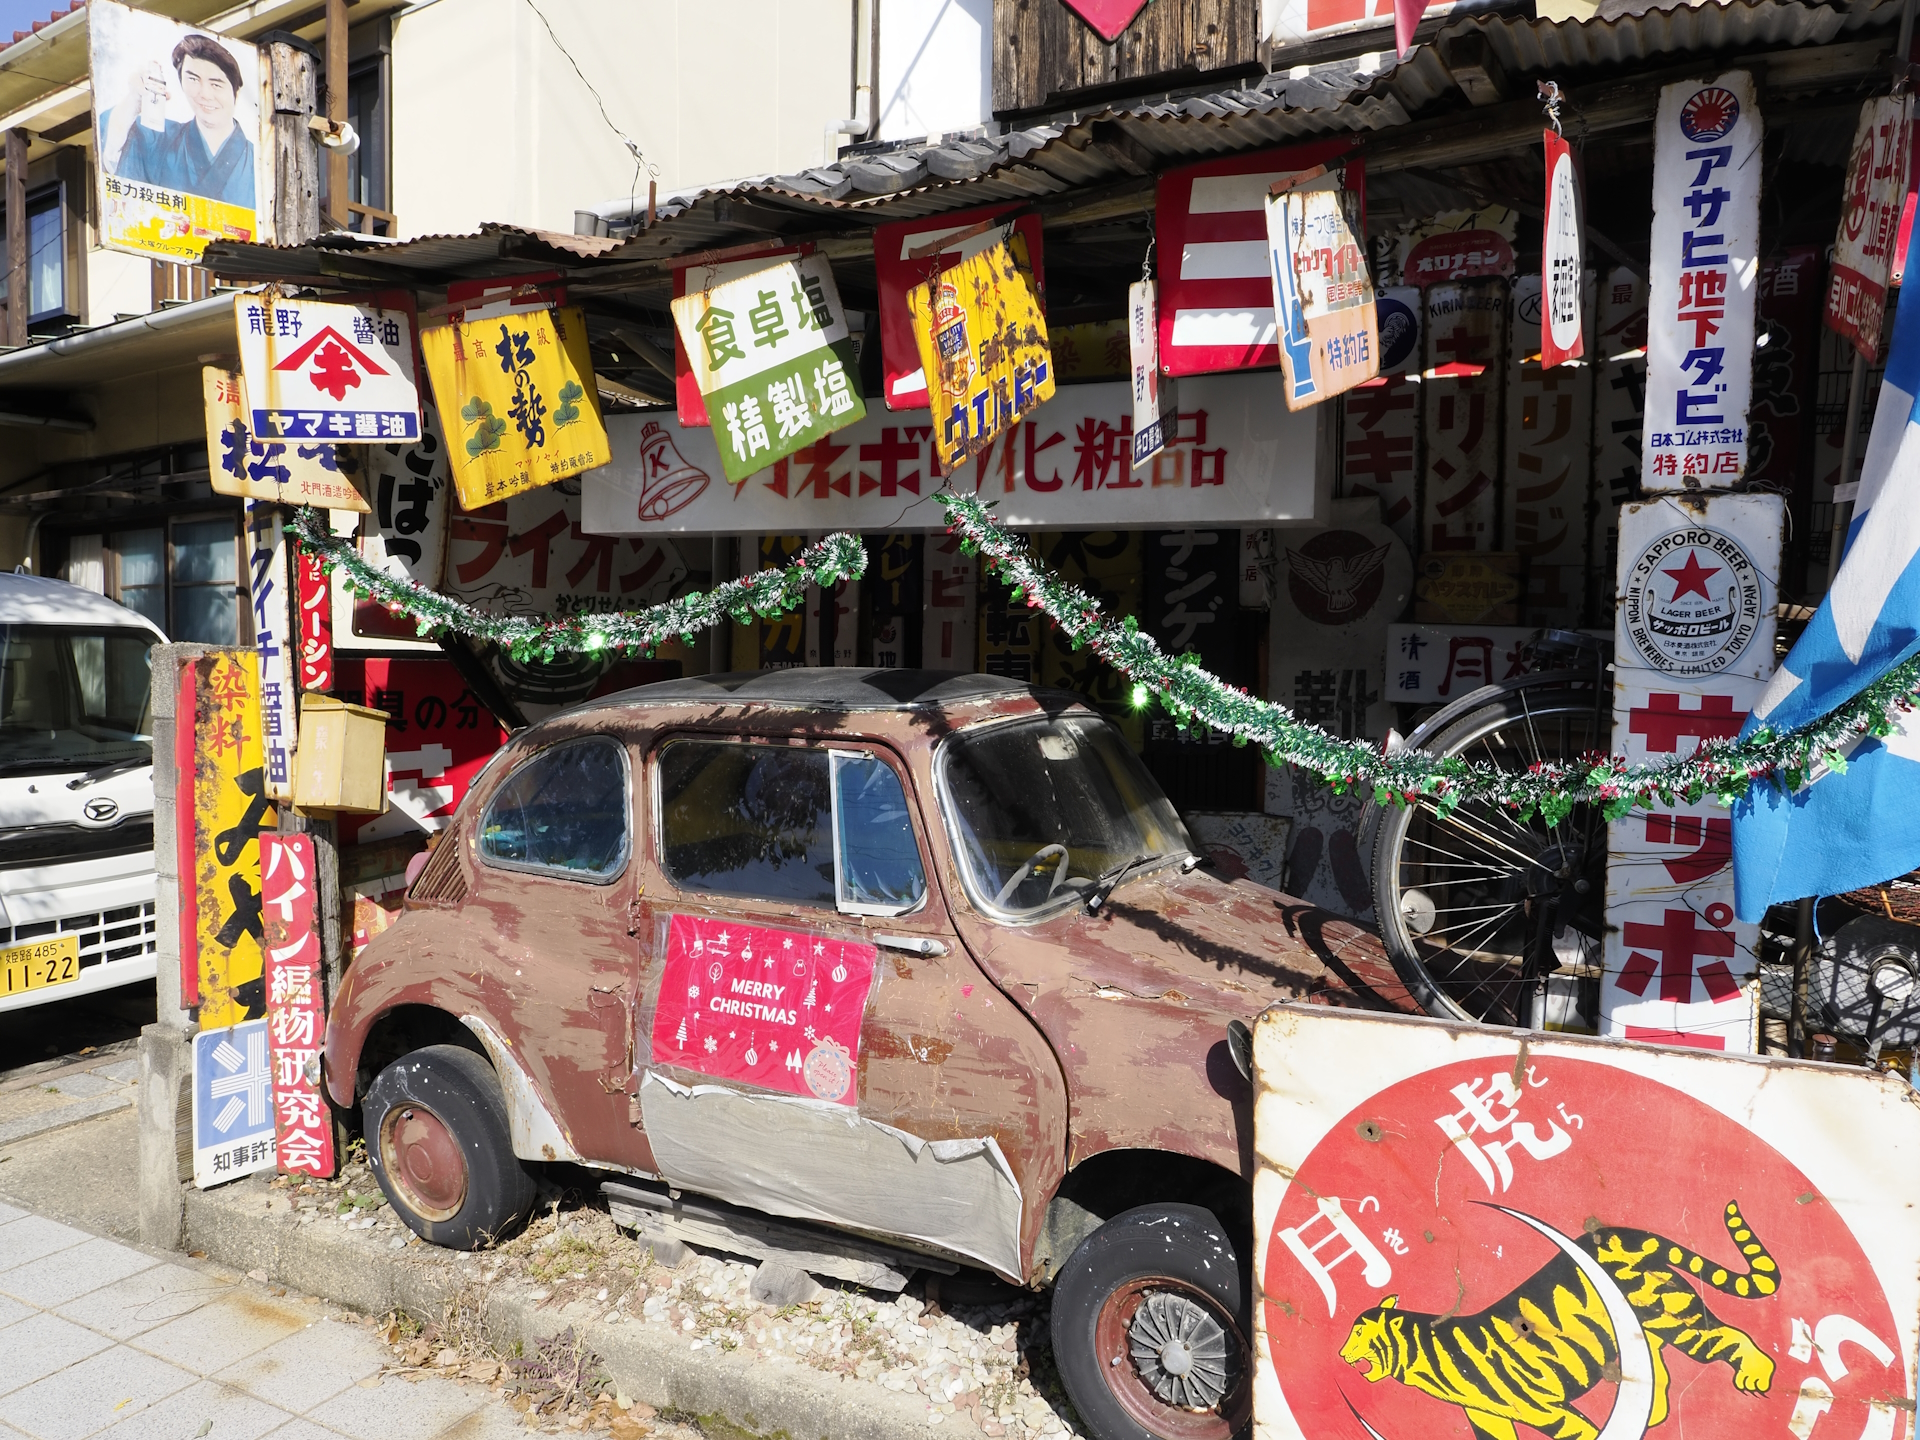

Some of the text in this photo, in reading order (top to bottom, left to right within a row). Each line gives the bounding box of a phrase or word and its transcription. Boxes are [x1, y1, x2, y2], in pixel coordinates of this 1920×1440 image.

[106, 176, 187, 211] 強力殺虫剤
[139, 238, 184, 254] 大塚グループ
[1416, 249, 1500, 273] オロナミン
[1675, 144, 1734, 427] アサヒ地下タビ
[247, 305, 303, 339] 龍野
[695, 273, 834, 373] 食卓塩
[1428, 297, 1464, 318] KIRIN
[1465, 297, 1501, 313] BEER
[1326, 330, 1370, 372] 特約店
[496, 323, 547, 450] 松の勢
[722, 359, 855, 462] 精製塩
[1651, 427, 1743, 448] 日本ゴム株式会社
[1652, 451, 1740, 478] 特約店
[1637, 531, 1711, 575] SAPPORO
[1713, 537, 1748, 573] BEER
[1421, 580, 1514, 600] ハウスカレー
[1652, 619, 1730, 636] サッポロビール
[1660, 605, 1722, 618] LAGER BEER
[304, 584, 329, 690] ノーシン
[1628, 584, 1757, 675] NIPPON BREWERIES LIMITED TOKYO JAPAN
[1400, 633, 1428, 691] 清酒
[207, 667, 252, 760] 染料
[5, 943, 58, 965] 姫路 485
[7, 956, 74, 992] 11-22
[730, 977, 785, 1001] MERRY
[266, 841, 325, 1172] パイン編物研究会
[709, 996, 798, 1026] CHRISTMAS
[813, 1069, 828, 1081] open
[1434, 1071, 1573, 1197] 虎
[1277, 1195, 1393, 1320] 月
